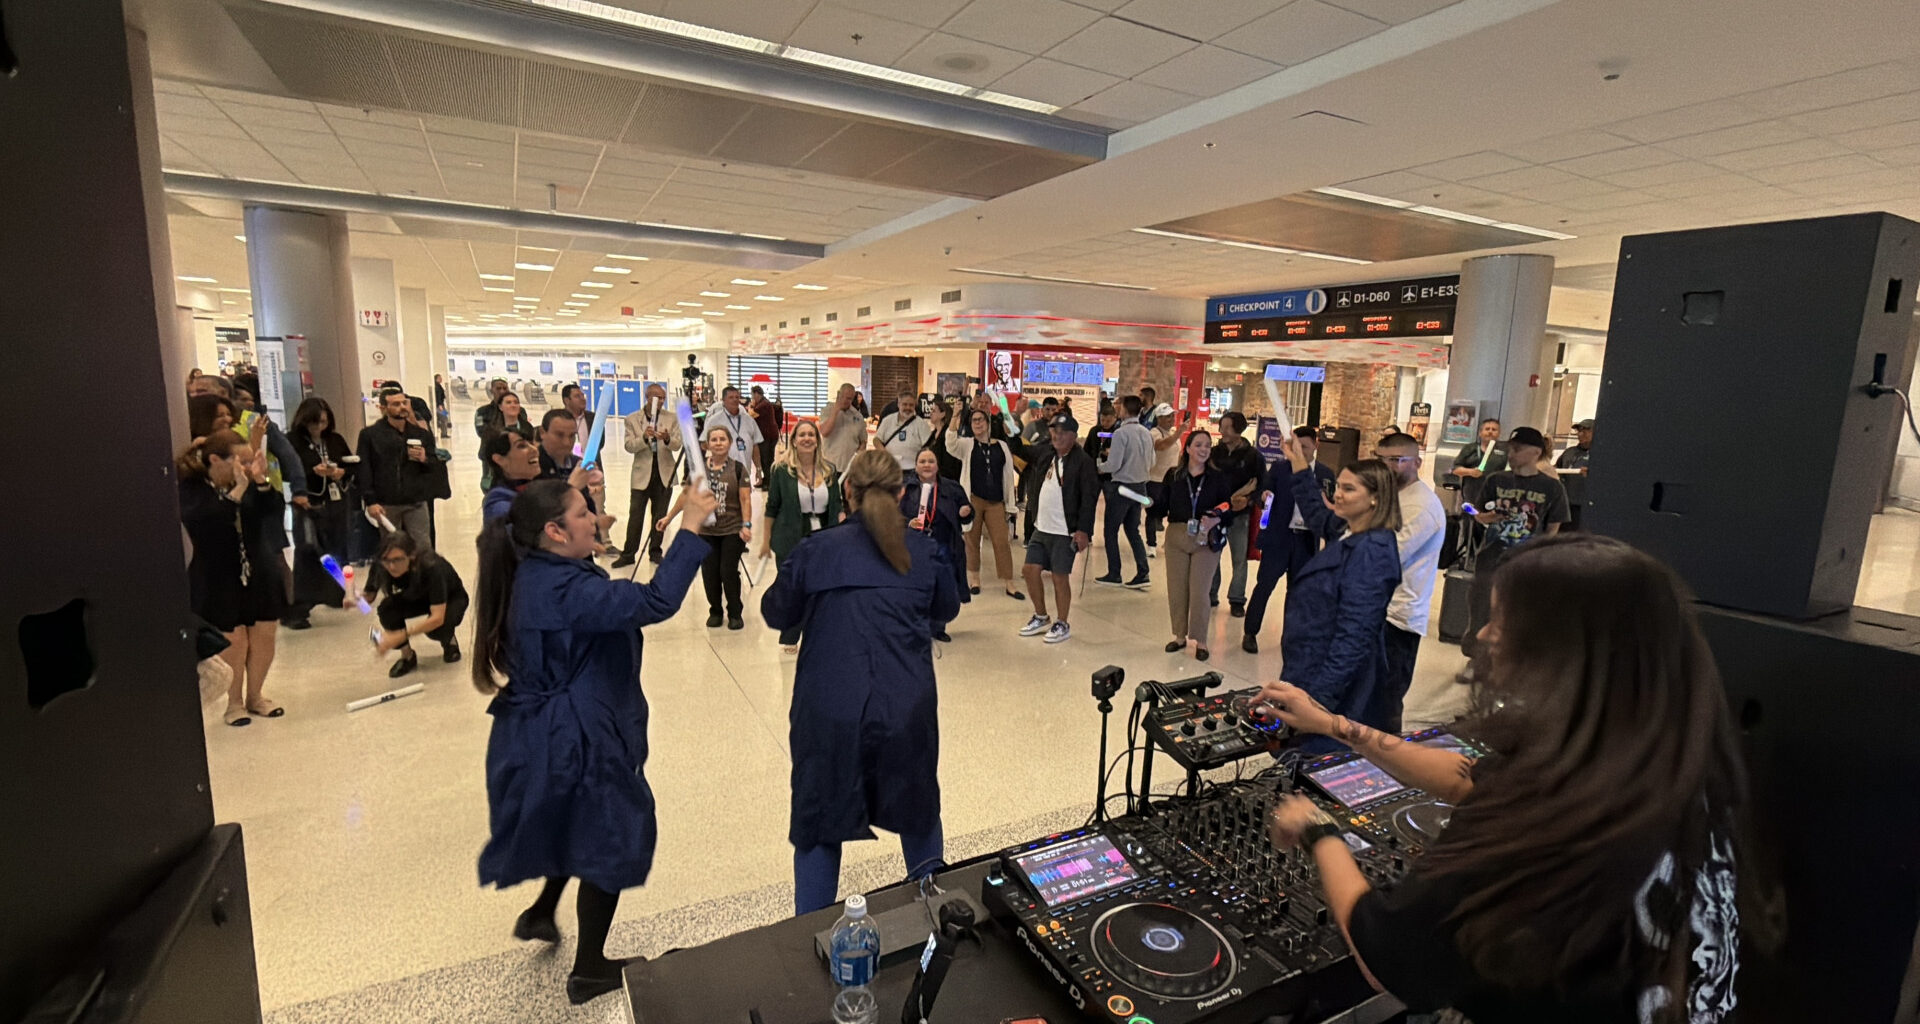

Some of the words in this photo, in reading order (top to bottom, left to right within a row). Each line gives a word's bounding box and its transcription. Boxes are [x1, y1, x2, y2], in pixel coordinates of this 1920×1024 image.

[1353, 291, 1391, 304] D1-D60
[1421, 284, 1460, 298] E1-E33
[1229, 300, 1280, 313] CHECKPOINT
[1285, 298, 1292, 309] 4
[1526, 491, 1546, 503] US
[1016, 926, 1068, 985] Pioneer
[1197, 993, 1230, 1011] Pioneer
